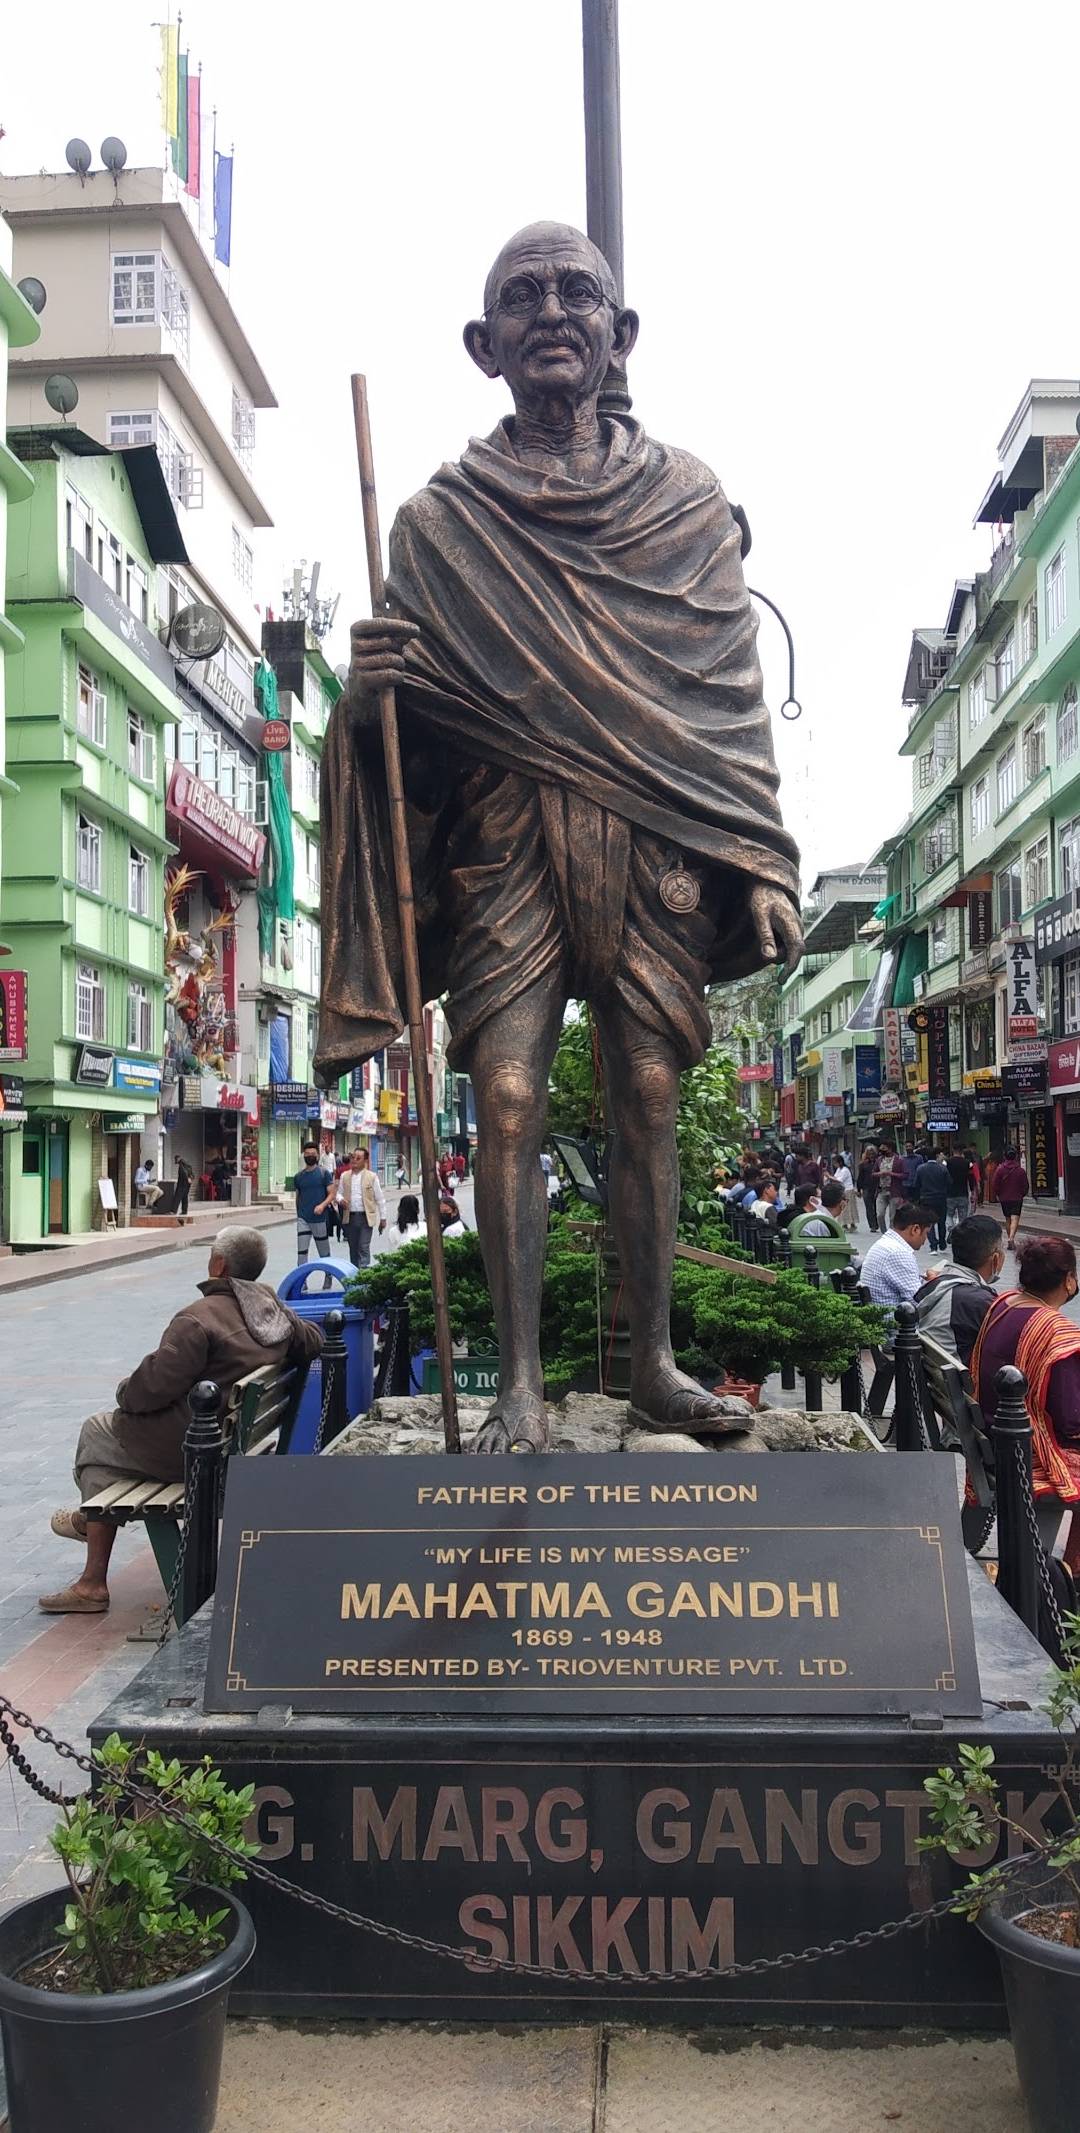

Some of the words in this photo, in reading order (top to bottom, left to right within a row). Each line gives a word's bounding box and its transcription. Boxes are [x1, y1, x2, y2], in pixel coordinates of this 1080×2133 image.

[264, 736, 287, 744] BAND
[186, 777, 206, 812] THE
[205, 794, 241, 839] DRAGON
[239, 822, 259, 855] WOK
[852, 876, 882, 885] DZONG
[1009, 943, 1035, 1015] ALFA
[9, 975, 17, 1048] AMUSEMENT
[1011, 1019, 1036, 1027] ALFA
[886, 1010, 899, 1076] PARIVAR
[276, 1084, 307, 1093] DESIRE
[417, 1485, 528, 1505] FATHER
[536, 1485, 576, 1504] OF
[584, 1485, 641, 1503] THE
[650, 1484, 759, 1503] NATION
[479, 1547, 532, 1564] LIFE
[540, 1547, 562, 1564] IS
[570, 1547, 608, 1563] MY
[340, 1582, 613, 1619] MAHATMA
[626, 1581, 840, 1619] GANDHI
[511, 1629, 573, 1647] 1869
[600, 1629, 664, 1646] 1948
[324, 1658, 479, 1677] PRESENTED
[487, 1658, 530, 1677] BY-
[537, 1658, 722, 1677] TRIOVENTURE
[729, 1658, 783, 1676] PVT.
[799, 1658, 854, 1676] LTD.
[352, 1785, 605, 1874] MARG,
[636, 1787, 1063, 1868] GANGTOK
[458, 1893, 737, 1975] SIKKIM
